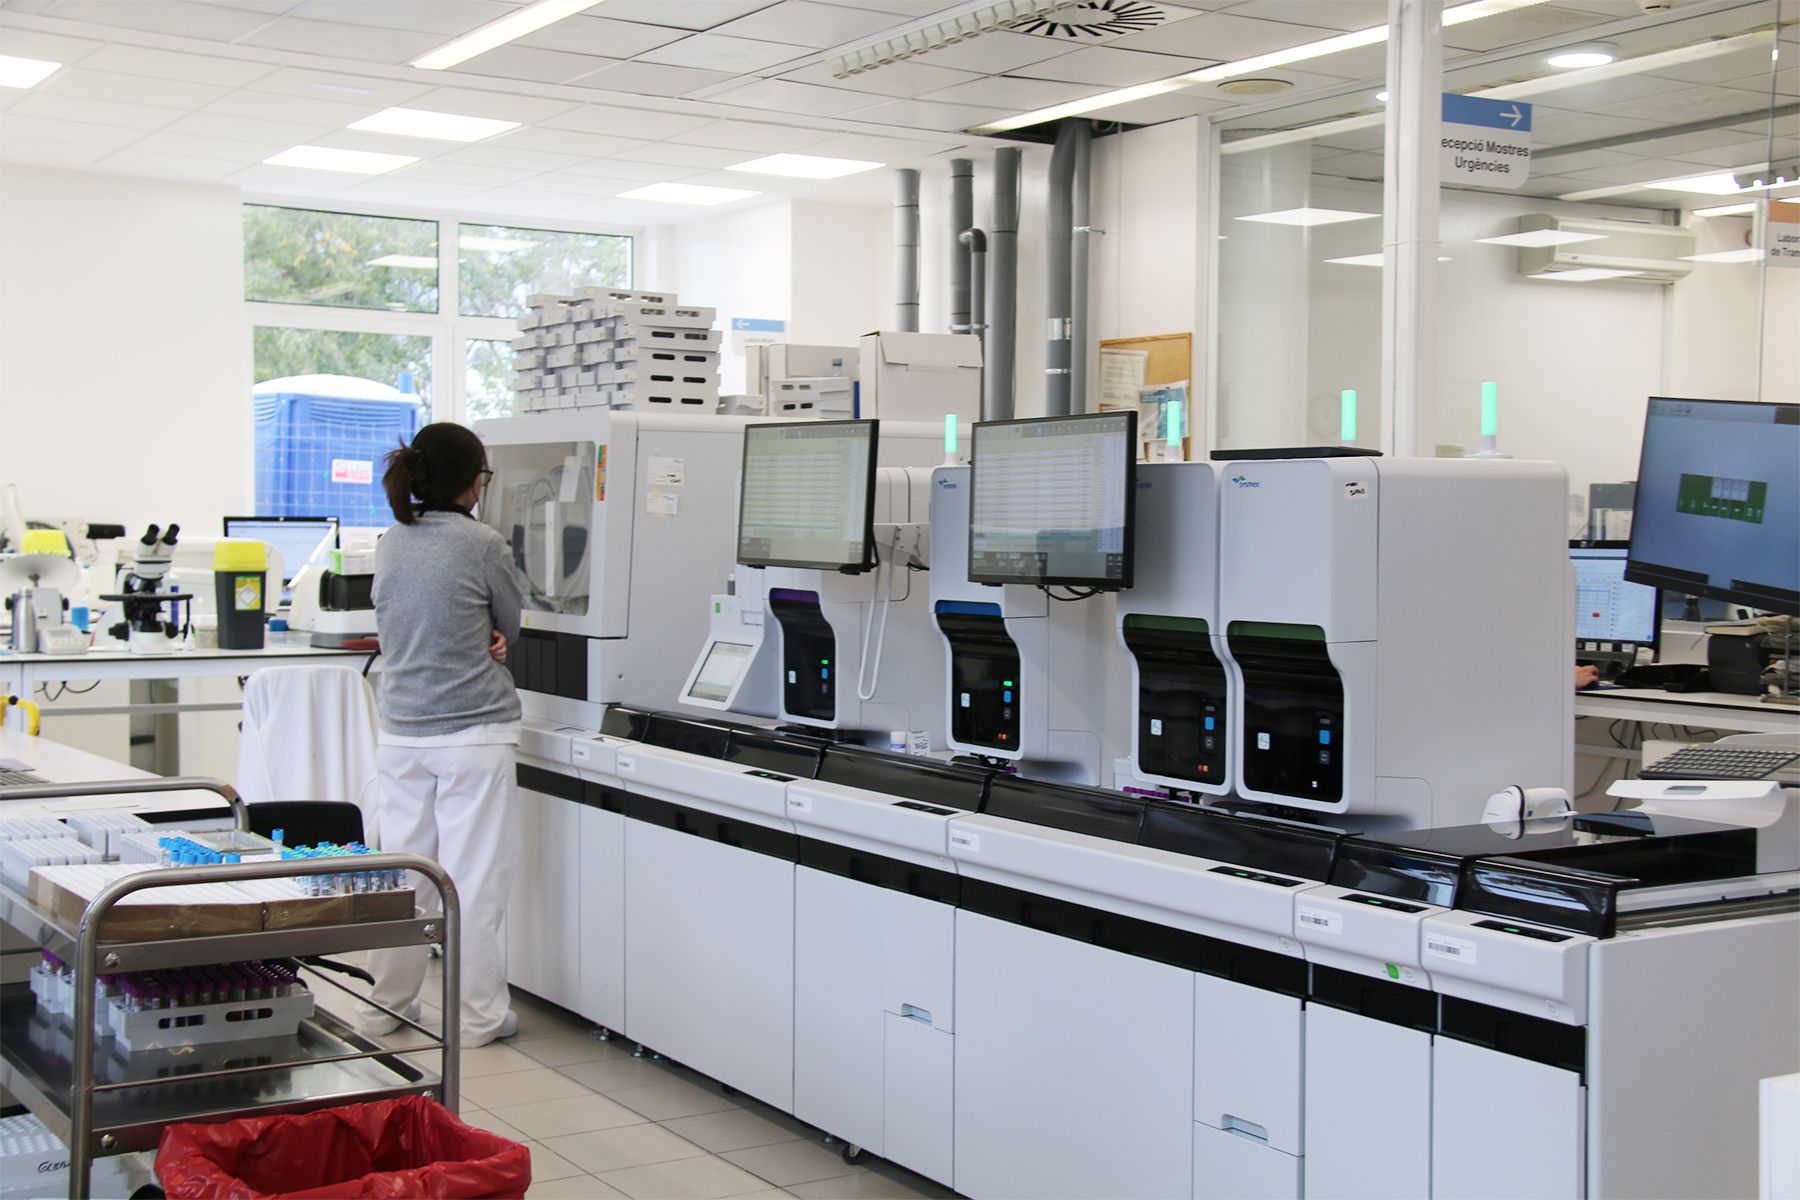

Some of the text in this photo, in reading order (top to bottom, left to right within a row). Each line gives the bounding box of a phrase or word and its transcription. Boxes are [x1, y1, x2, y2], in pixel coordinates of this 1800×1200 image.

[1441, 138, 1529, 156] ecepció Mostres
[1455, 156, 1510, 173] Urgències
